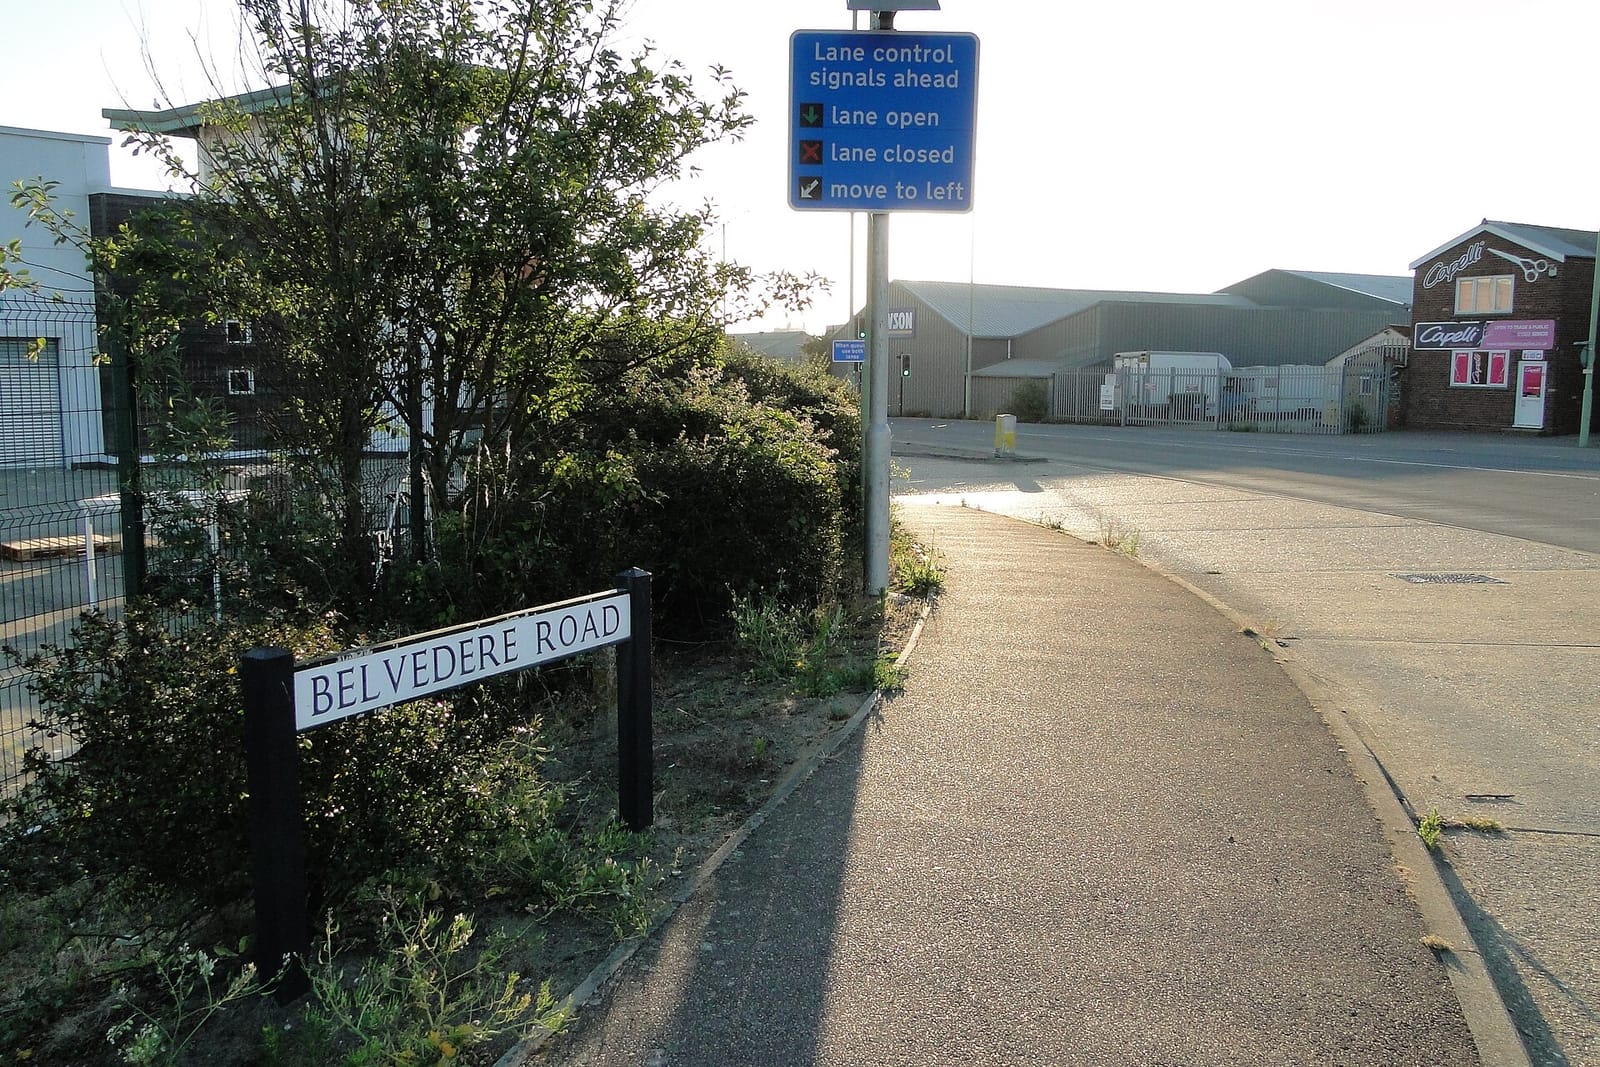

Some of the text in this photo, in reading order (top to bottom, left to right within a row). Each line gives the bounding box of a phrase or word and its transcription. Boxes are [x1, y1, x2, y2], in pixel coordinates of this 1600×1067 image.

[815, 42, 954, 64] Lane control
[810, 67, 959, 89] signals ahead
[832, 106, 939, 129] lane open
[831, 143, 954, 164] lane closed
[831, 182, 964, 201] move to left
[1423, 240, 1486, 289] Capelli
[1419, 325, 1480, 347] Capelli
[311, 604, 620, 717] BELVEDERE ROAD
